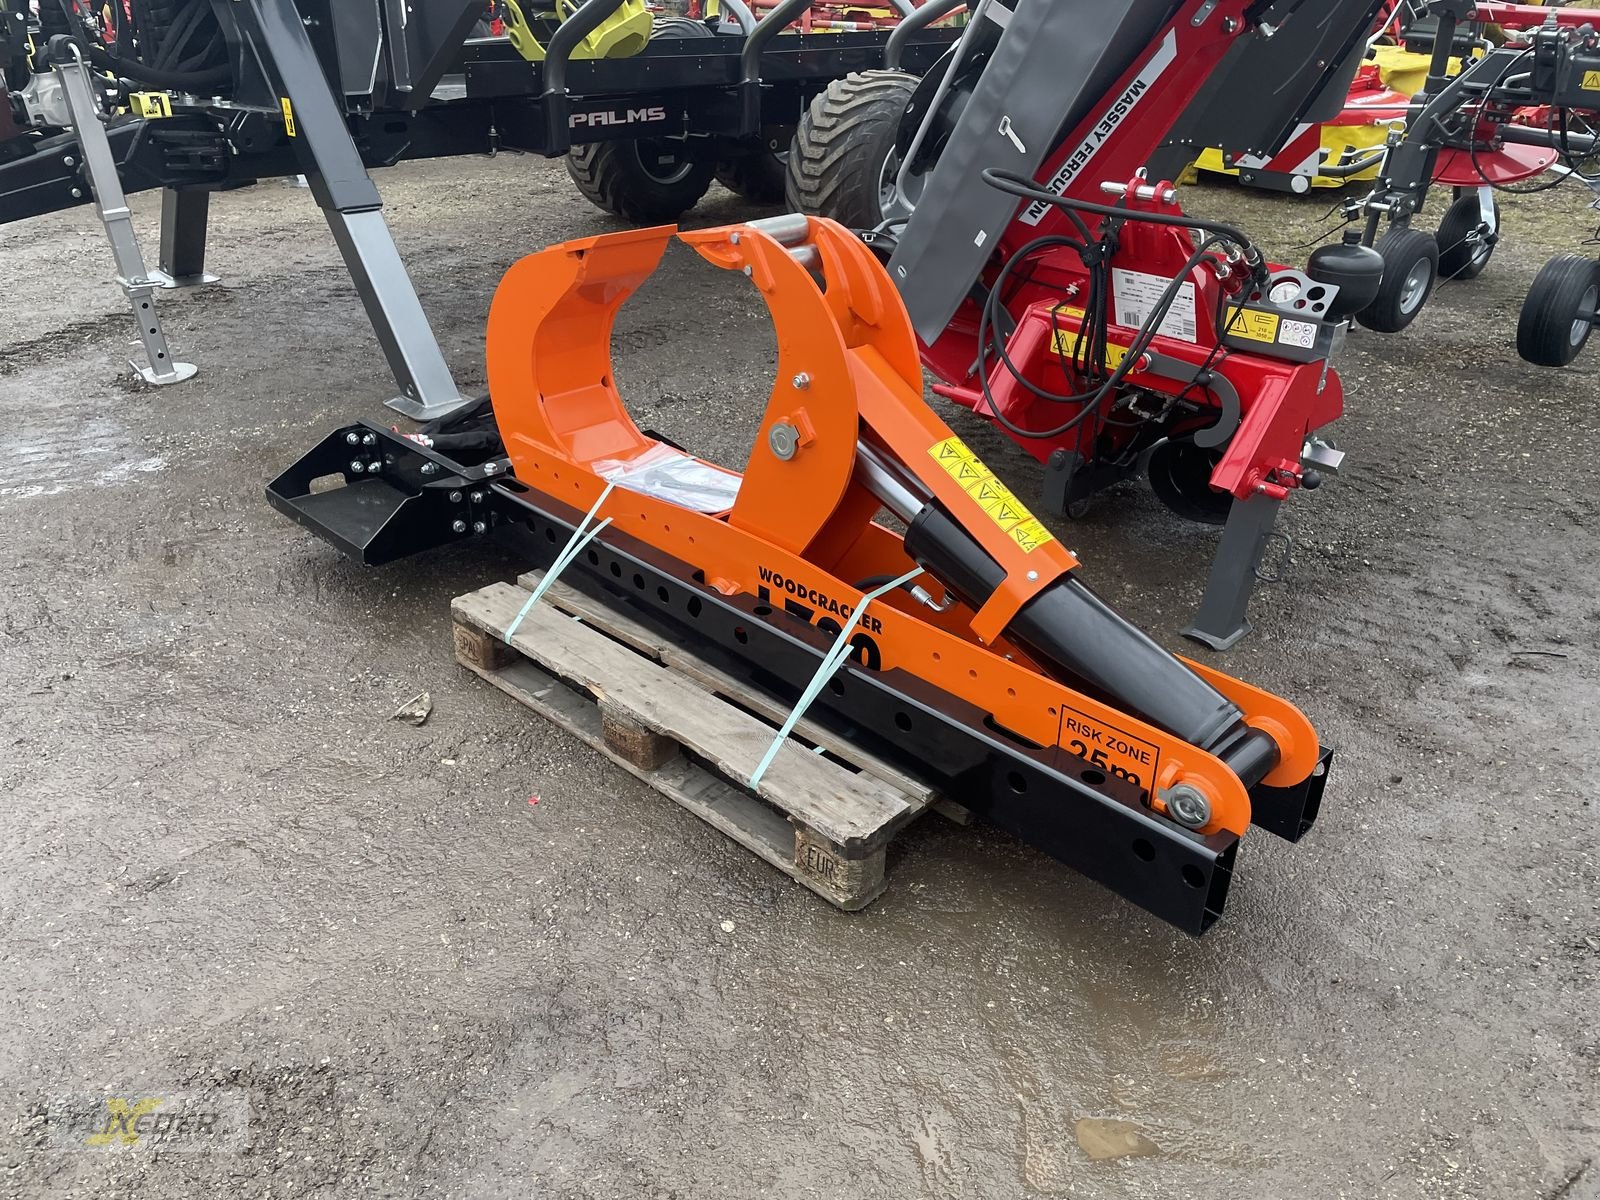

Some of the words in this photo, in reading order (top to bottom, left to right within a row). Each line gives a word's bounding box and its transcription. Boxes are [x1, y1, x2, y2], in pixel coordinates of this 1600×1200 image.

[568, 106, 666, 128] PALMS
[1094, 79, 1147, 143] MASSEY
[1066, 717, 1103, 744] RISK
[1105, 735, 1151, 766] ZONE
[807, 847, 834, 880] EUR
